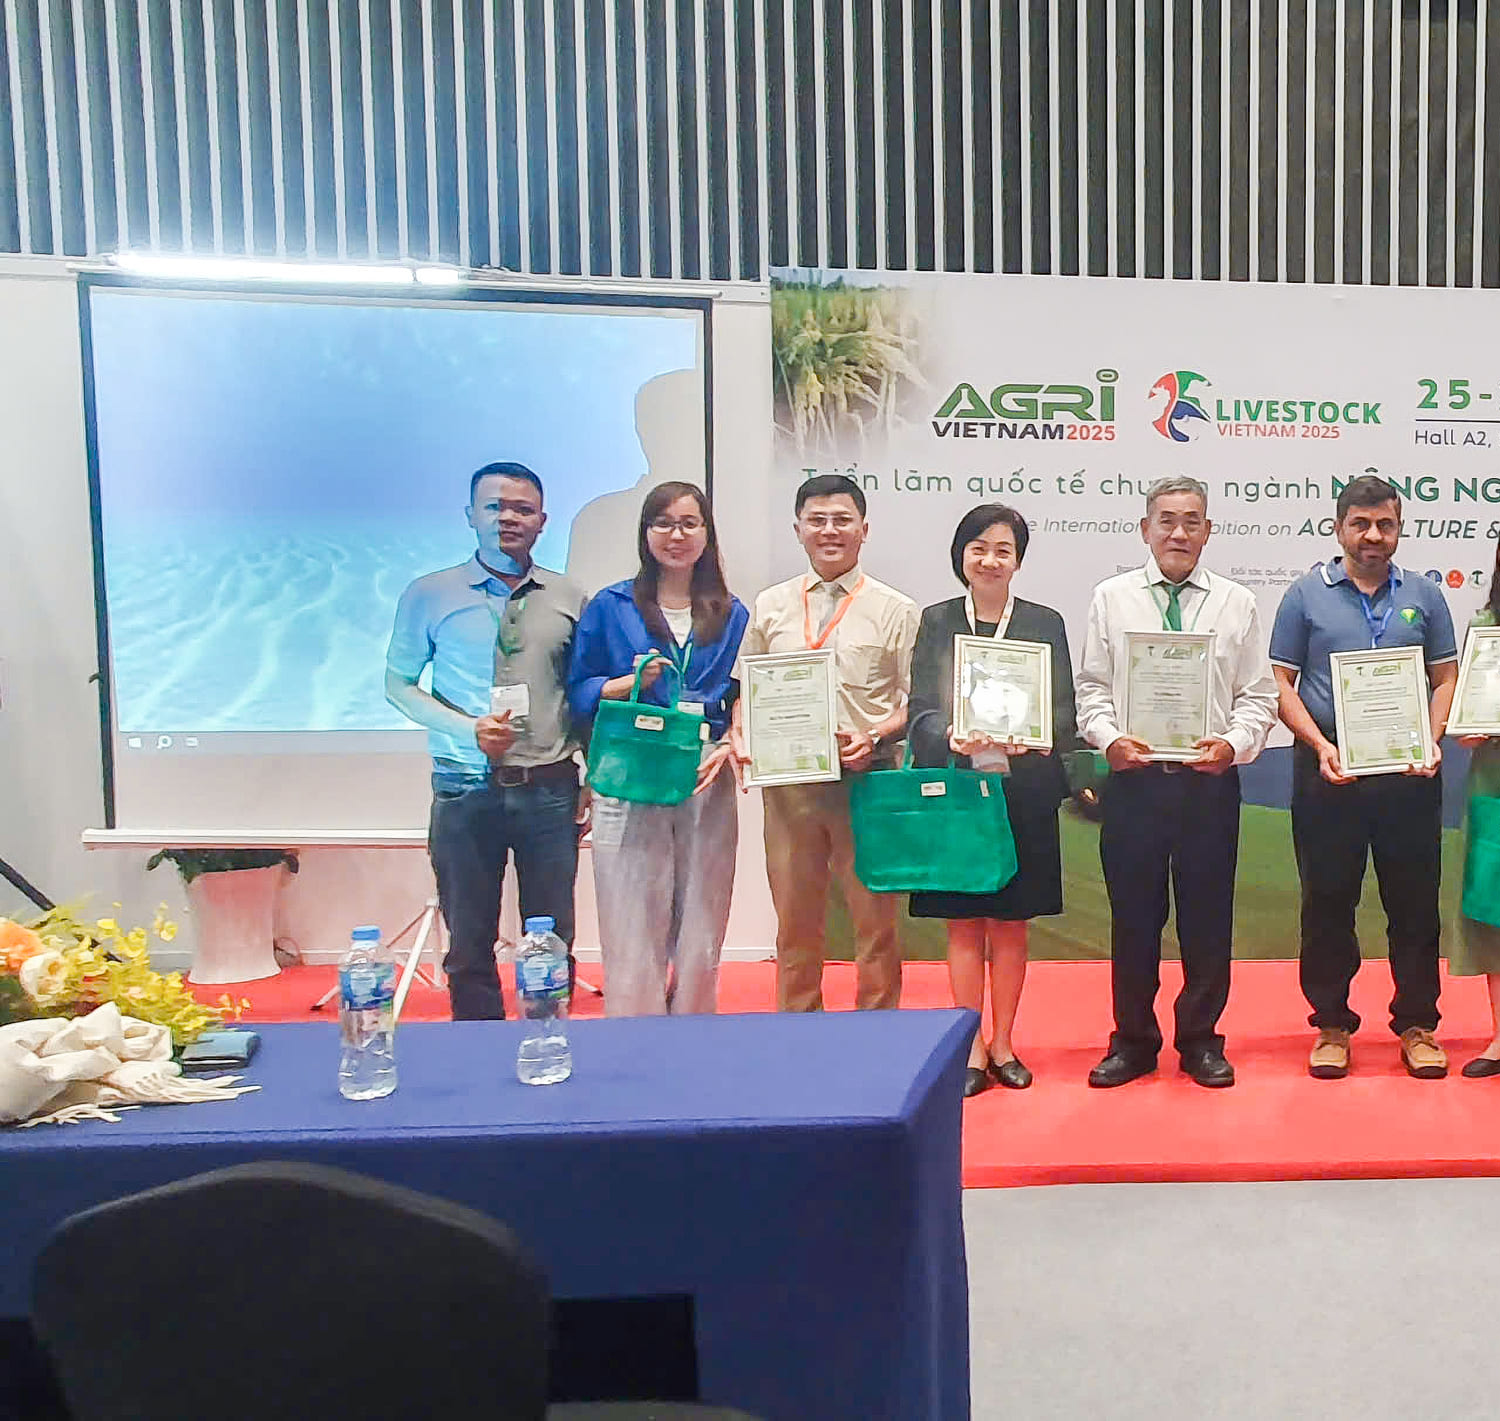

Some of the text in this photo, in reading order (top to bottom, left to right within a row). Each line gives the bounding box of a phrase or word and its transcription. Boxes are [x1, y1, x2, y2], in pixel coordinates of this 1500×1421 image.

[1217, 399, 1381, 425] LIVESTOCK
[1217, 423, 1341, 439] VIETNAM 2025
[1414, 430, 1455, 447] Hall
[1463, 431, 1492, 449] A2,
[894, 469, 952, 493] lãm
[966, 467, 1042, 498] quốc
[1057, 468, 1087, 495] tế
[1224, 476, 1321, 502] ngành
[1268, 524, 1291, 536] on
